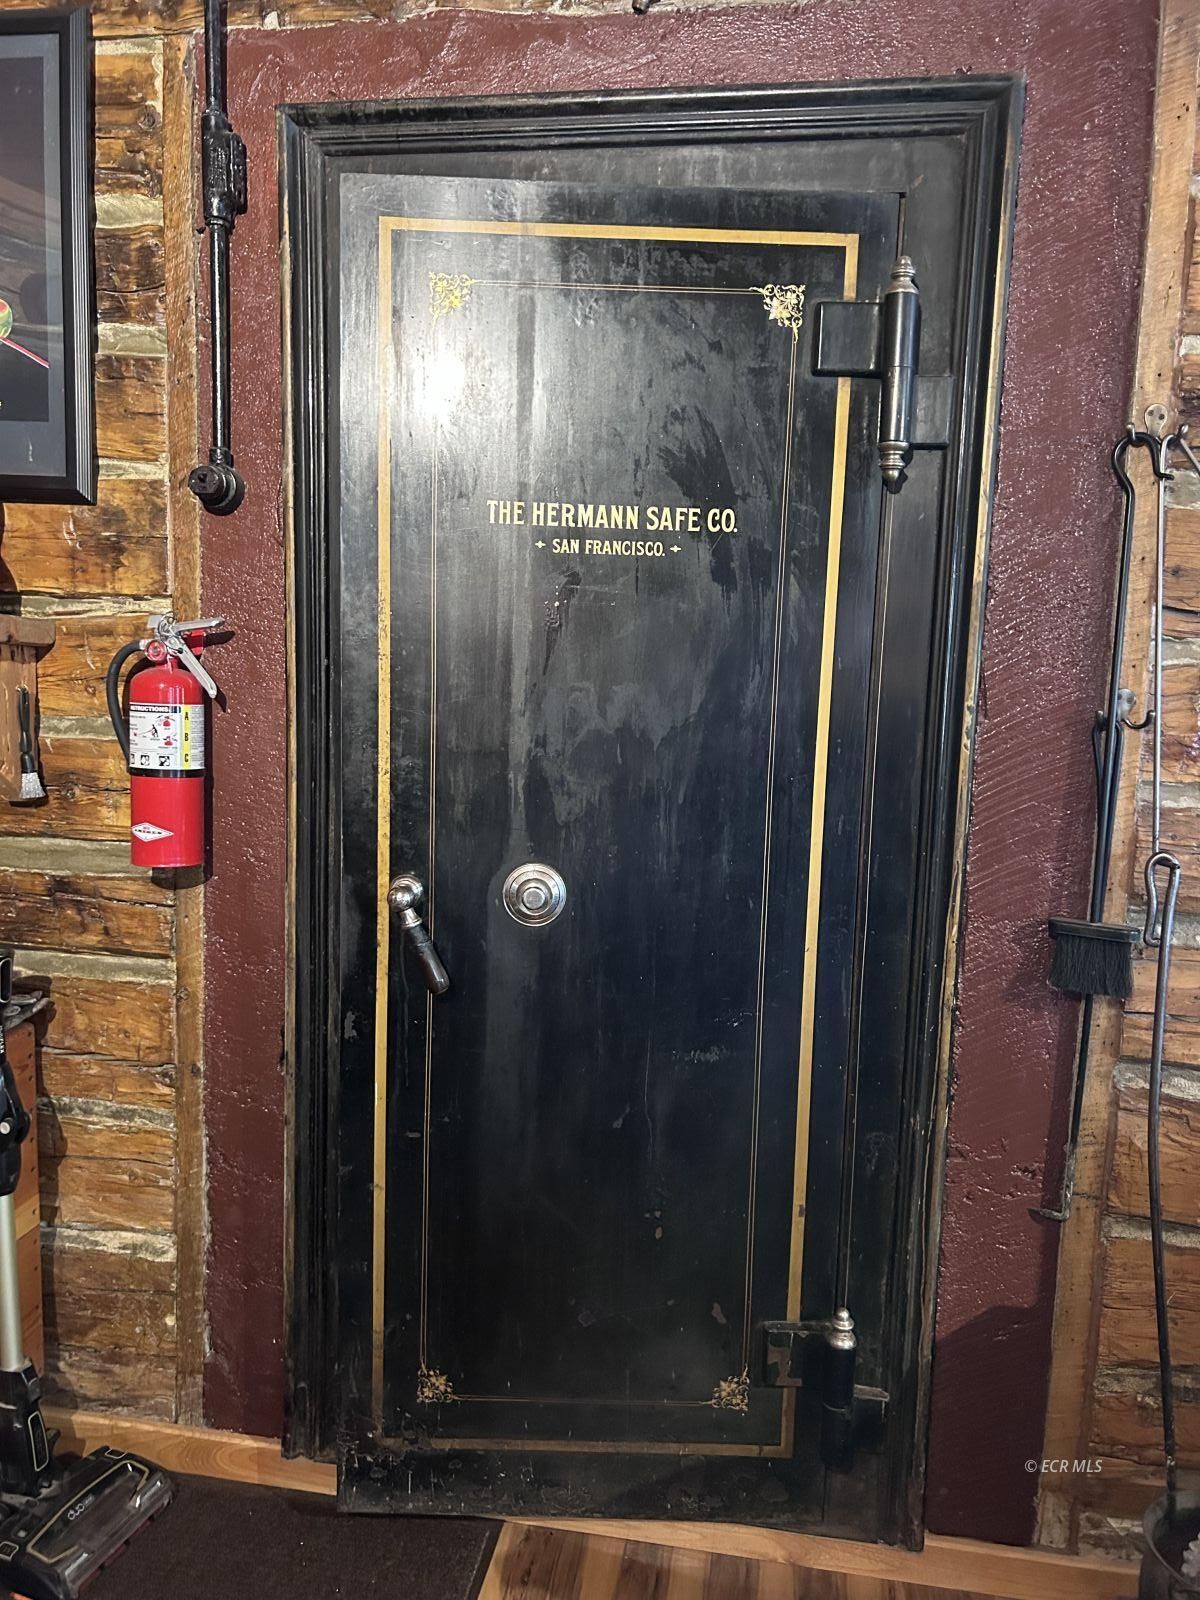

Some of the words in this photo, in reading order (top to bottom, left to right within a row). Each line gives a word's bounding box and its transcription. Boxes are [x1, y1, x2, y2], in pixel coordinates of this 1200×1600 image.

[487, 500, 525, 525] THE
[532, 502, 639, 529] HERMANN
[646, 506, 701, 532] SAFE
[707, 508, 738, 533] CO.
[552, 538, 579, 554] SAN
[585, 539, 665, 557] FRANCISCO.
[184, 711, 189, 721] A
[184, 732, 189, 741] B
[184, 753, 189, 762] C
